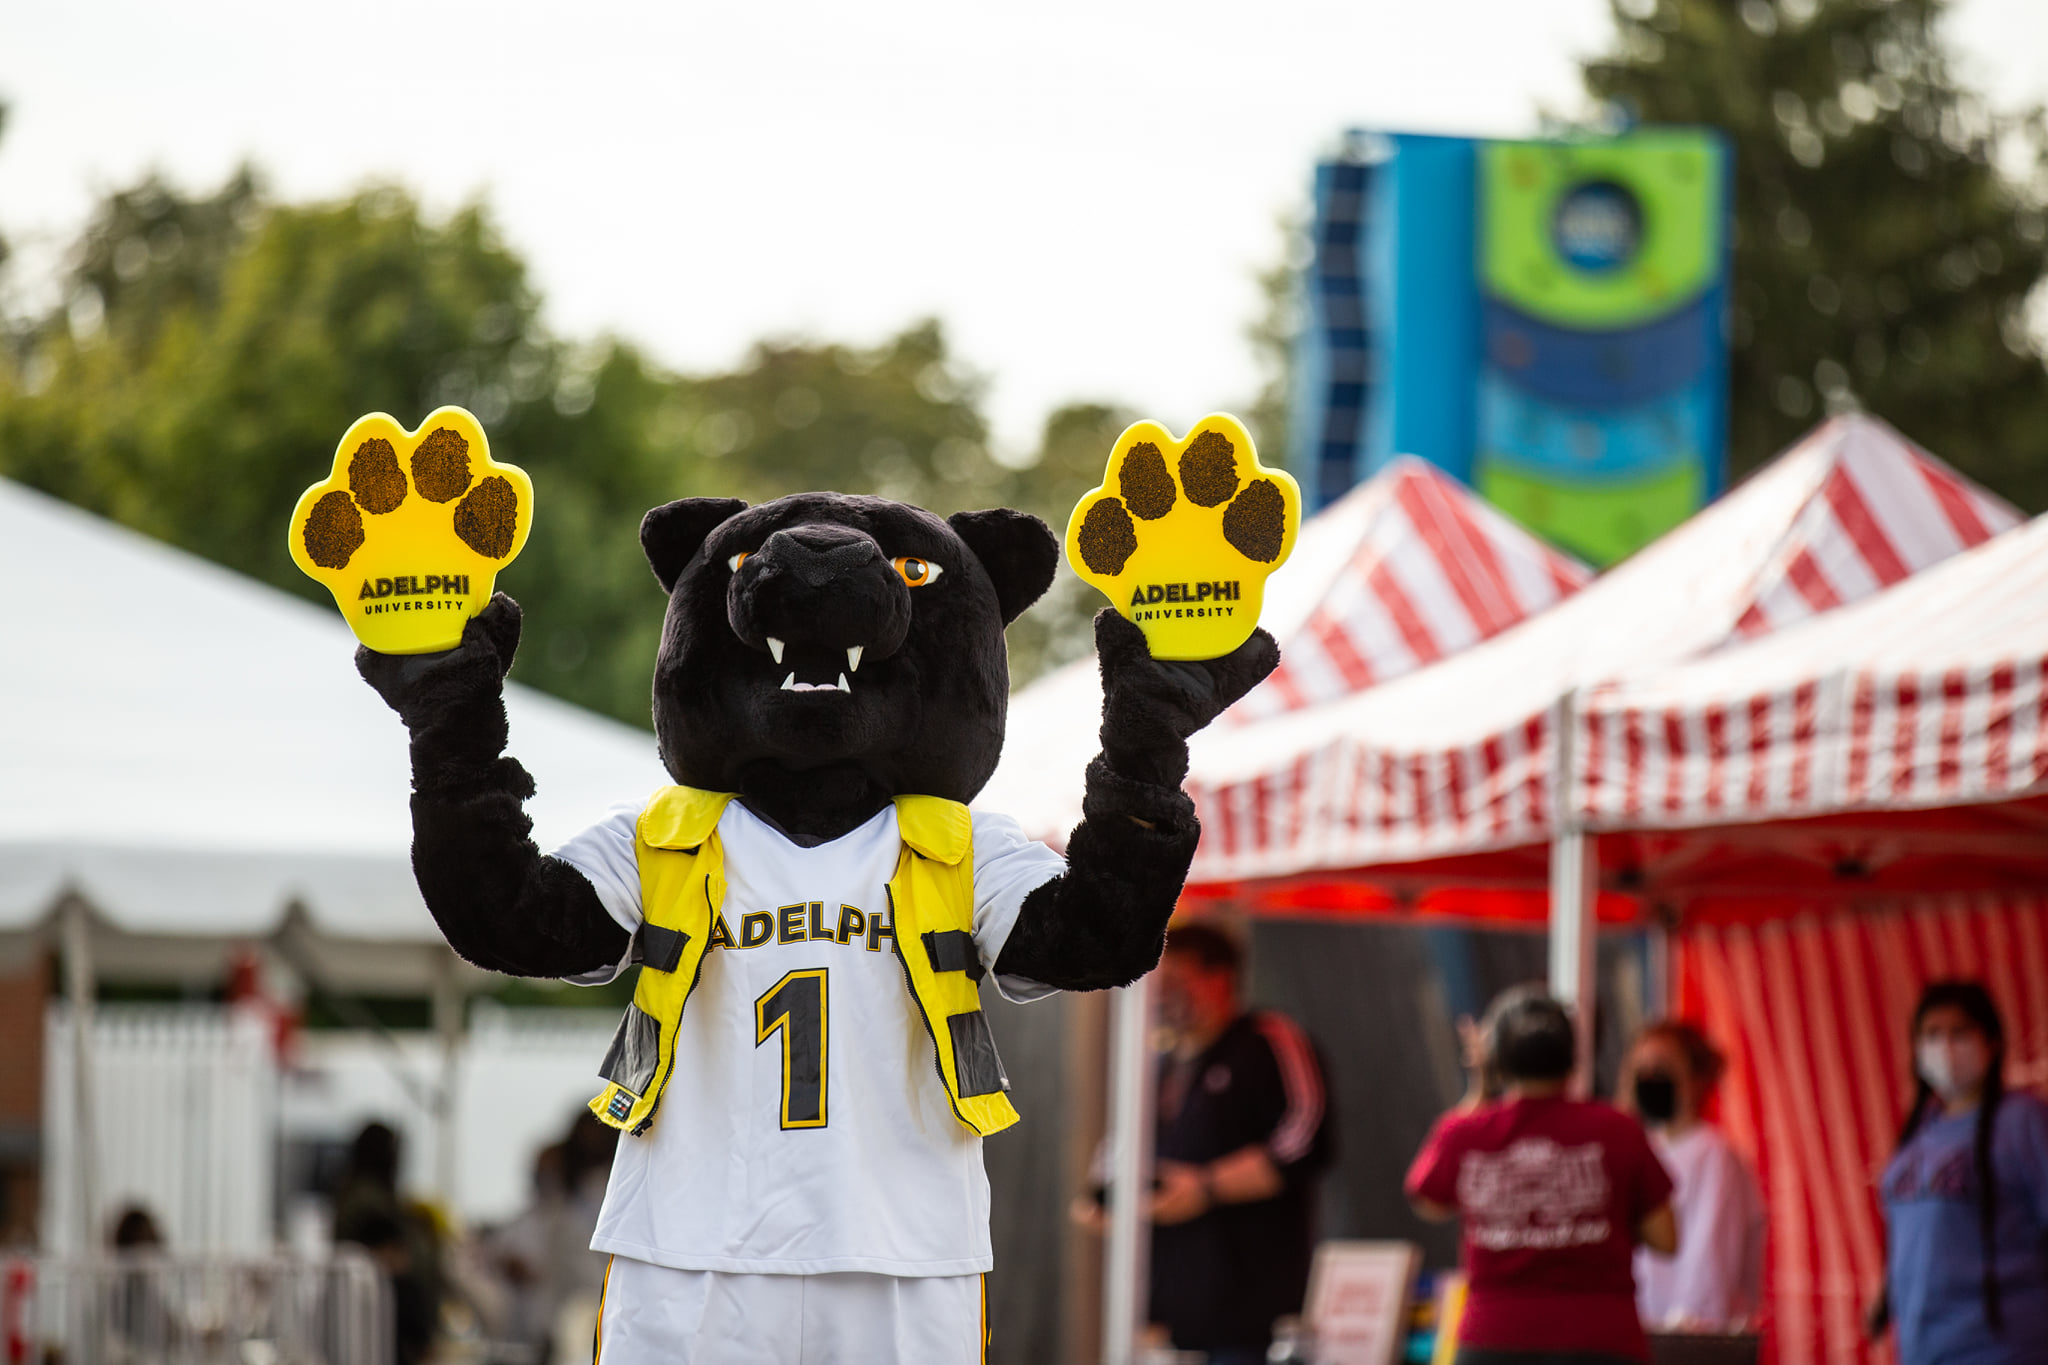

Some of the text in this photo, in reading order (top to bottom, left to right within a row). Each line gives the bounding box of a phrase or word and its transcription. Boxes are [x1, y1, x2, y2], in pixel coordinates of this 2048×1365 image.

[358, 574, 470, 600] ADELPHI
[1130, 581, 1241, 606] ADELPHI
[365, 601, 463, 615] UNIVERSITY
[1135, 607, 1234, 621] UNIVERSITY
[754, 967, 829, 1131] 1
